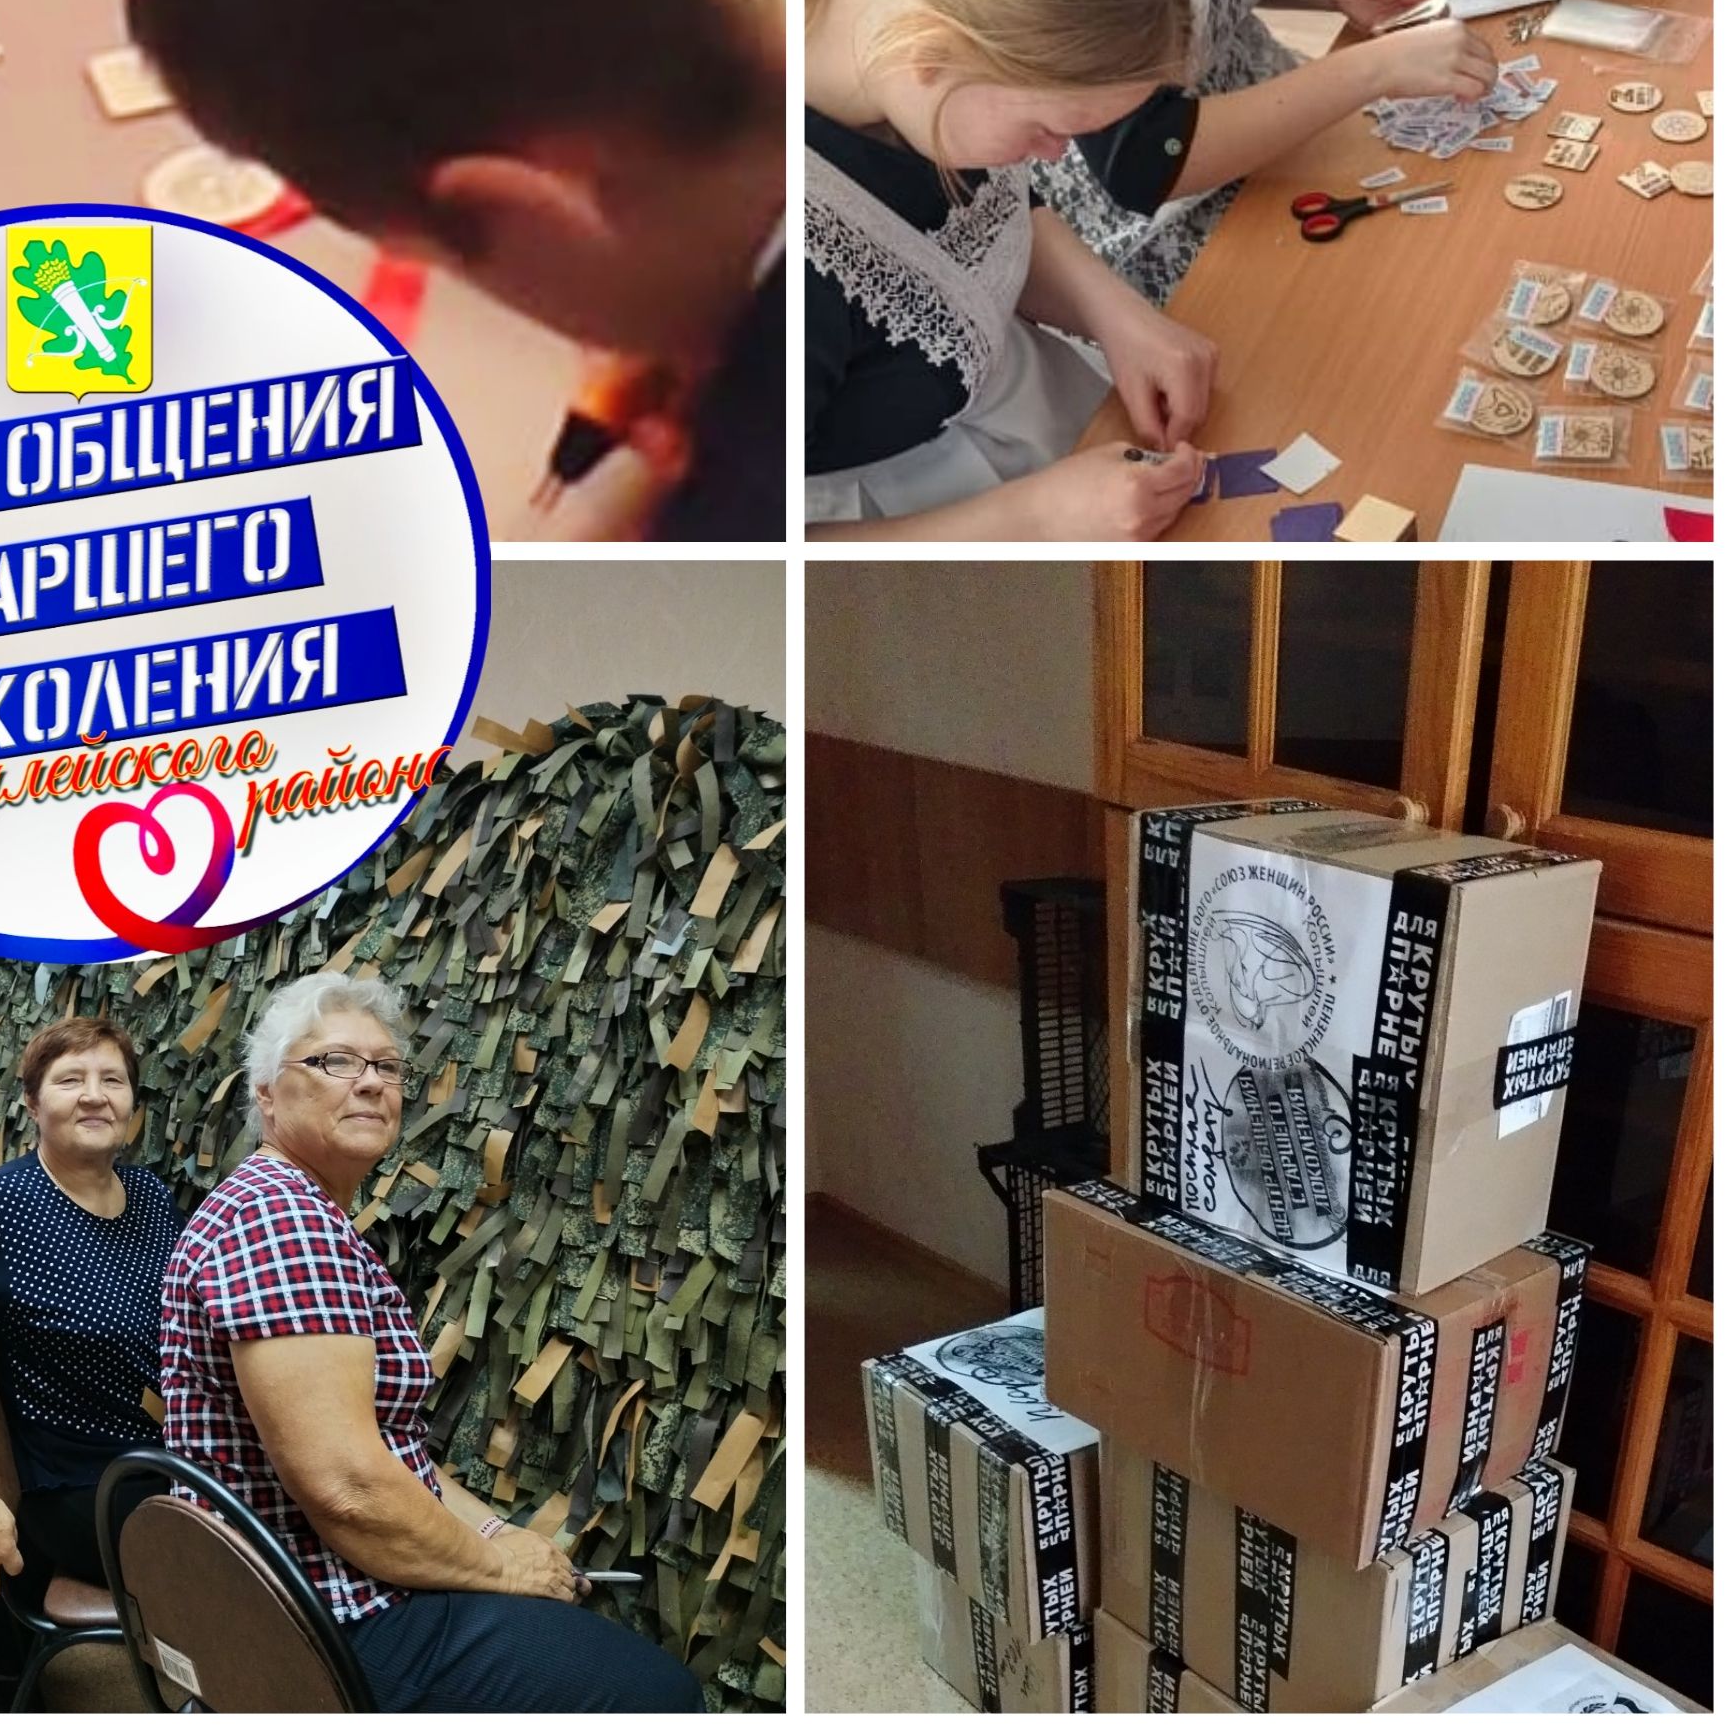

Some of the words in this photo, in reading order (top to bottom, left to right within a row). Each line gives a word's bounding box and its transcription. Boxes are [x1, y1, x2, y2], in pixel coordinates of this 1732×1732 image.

[1249, 865, 1309, 902] ЖЕНЩИН
[1393, 910, 1438, 939] ДЛЯ
[1187, 927, 1211, 1016] ОТДЕЛЕНИЕ
[1145, 1055, 1163, 1177] КРУТЫХ
[1268, 1100, 1306, 1205] СТАРШЕГО
[1287, 1088, 1328, 1208] ПОКОЛЕНИЯ
[1374, 1096, 1398, 1228] КРУТЫХ
[1353, 1264, 1391, 1287] ДЛЯ
[1399, 1326, 1419, 1428] КРУТЫ
[1476, 1346, 1501, 1455] КРУТЫХ
[1412, 1536, 1432, 1621] КРУТЫ
[1488, 1526, 1509, 1615] КРУТЫХ
